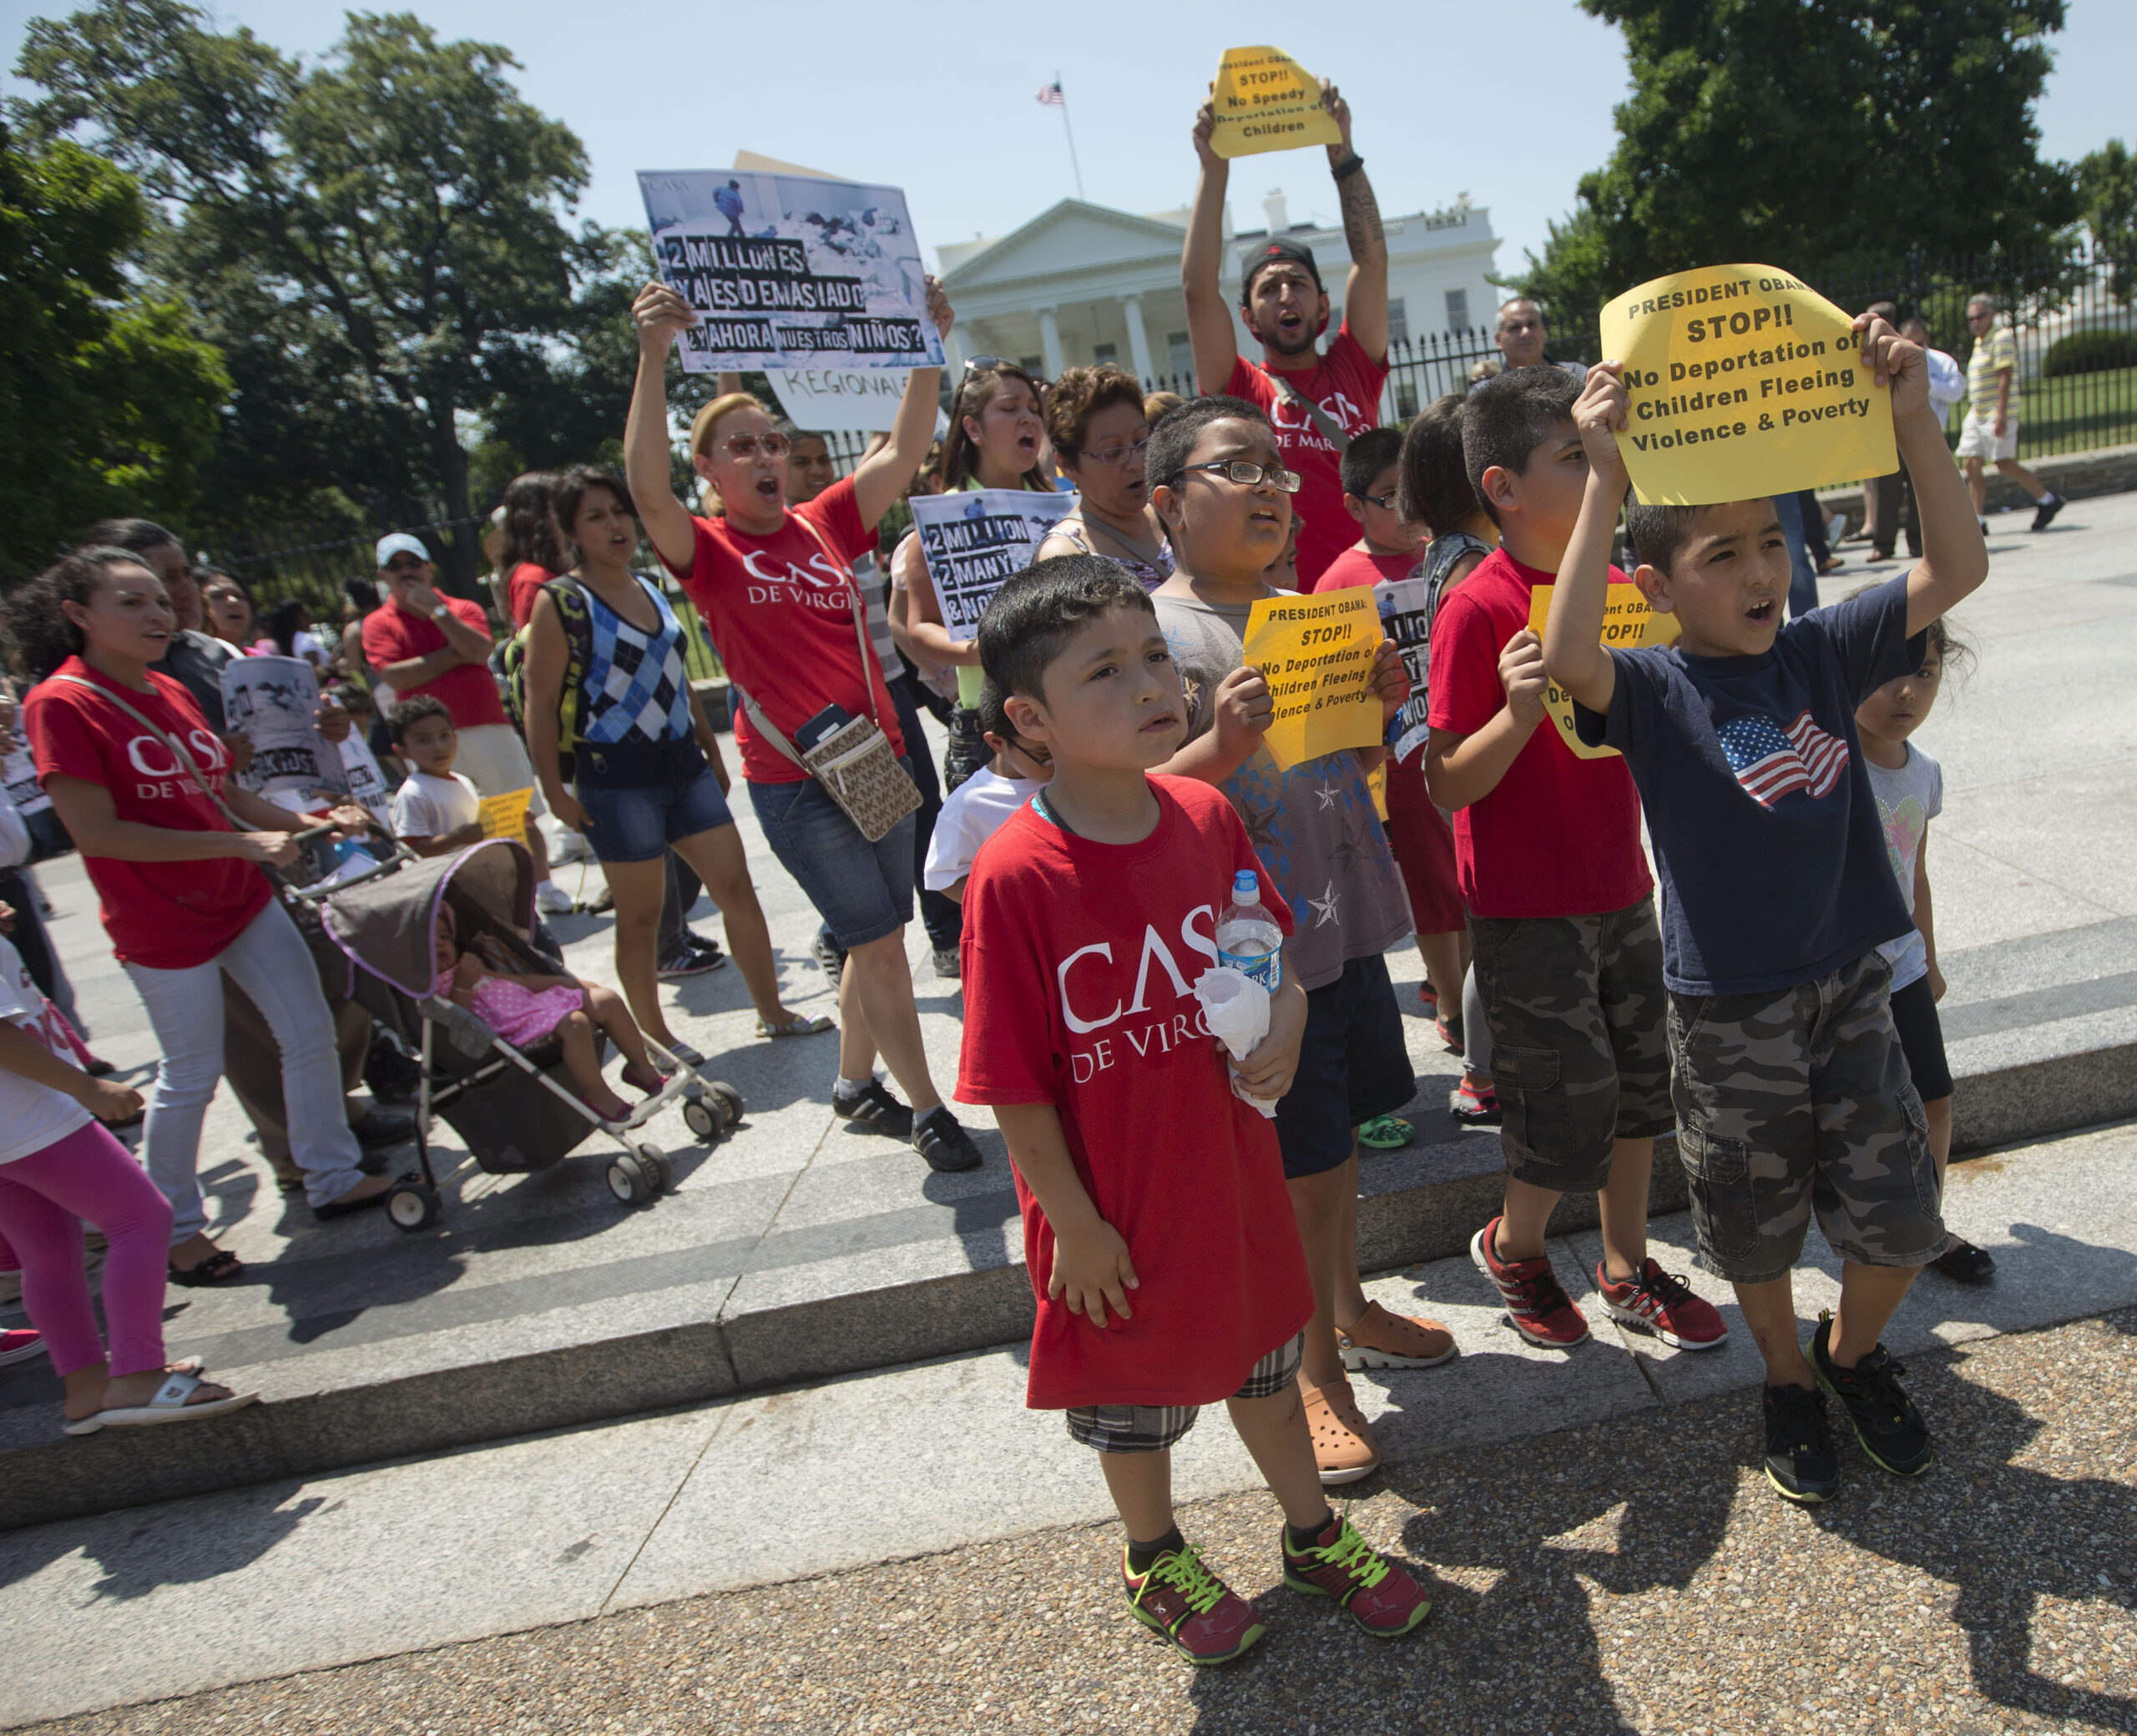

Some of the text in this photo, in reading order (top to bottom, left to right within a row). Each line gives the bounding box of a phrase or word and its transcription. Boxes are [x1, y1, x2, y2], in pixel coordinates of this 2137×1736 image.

[1220, 58, 1264, 69] resident
[1240, 68, 1288, 86] STOP!!
[1217, 99, 1323, 123] Deportation of
[1228, 88, 1305, 107] No Speedy
[1243, 122, 1305, 137] Children
[669, 240, 806, 273] 2 MILLONES
[1629, 280, 1751, 319] PRESIDENT
[709, 322, 771, 348] AHORA
[776, 330, 848, 350] NUESTROS
[1687, 304, 1793, 342] STOP!!
[1624, 329, 1859, 391] No Deportation of
[1637, 368, 1855, 420] Children Fleeing
[1632, 398, 1870, 452] Violence & Poverty
[928, 520, 1028, 551] 2 MILLION
[743, 549, 854, 588] CAS
[939, 553, 1012, 588] 2 MANY
[748, 586, 782, 604] DE
[947, 593, 993, 621] & NO
[1626, 603, 1656, 613] OBA
[1269, 598, 1367, 621] PRESIDENT OBAMA:
[1301, 623, 1351, 646] STOP!!
[1262, 663, 1280, 675] No
[1286, 649, 1359, 672] Deportation
[1322, 669, 1366, 687] Fleeing
[1271, 689, 1367, 719] olence & Poverty
[136, 781, 174, 799] DE
[1058, 905, 1220, 1034] CAS
[1072, 1008, 1215, 1083] DE VIRG
